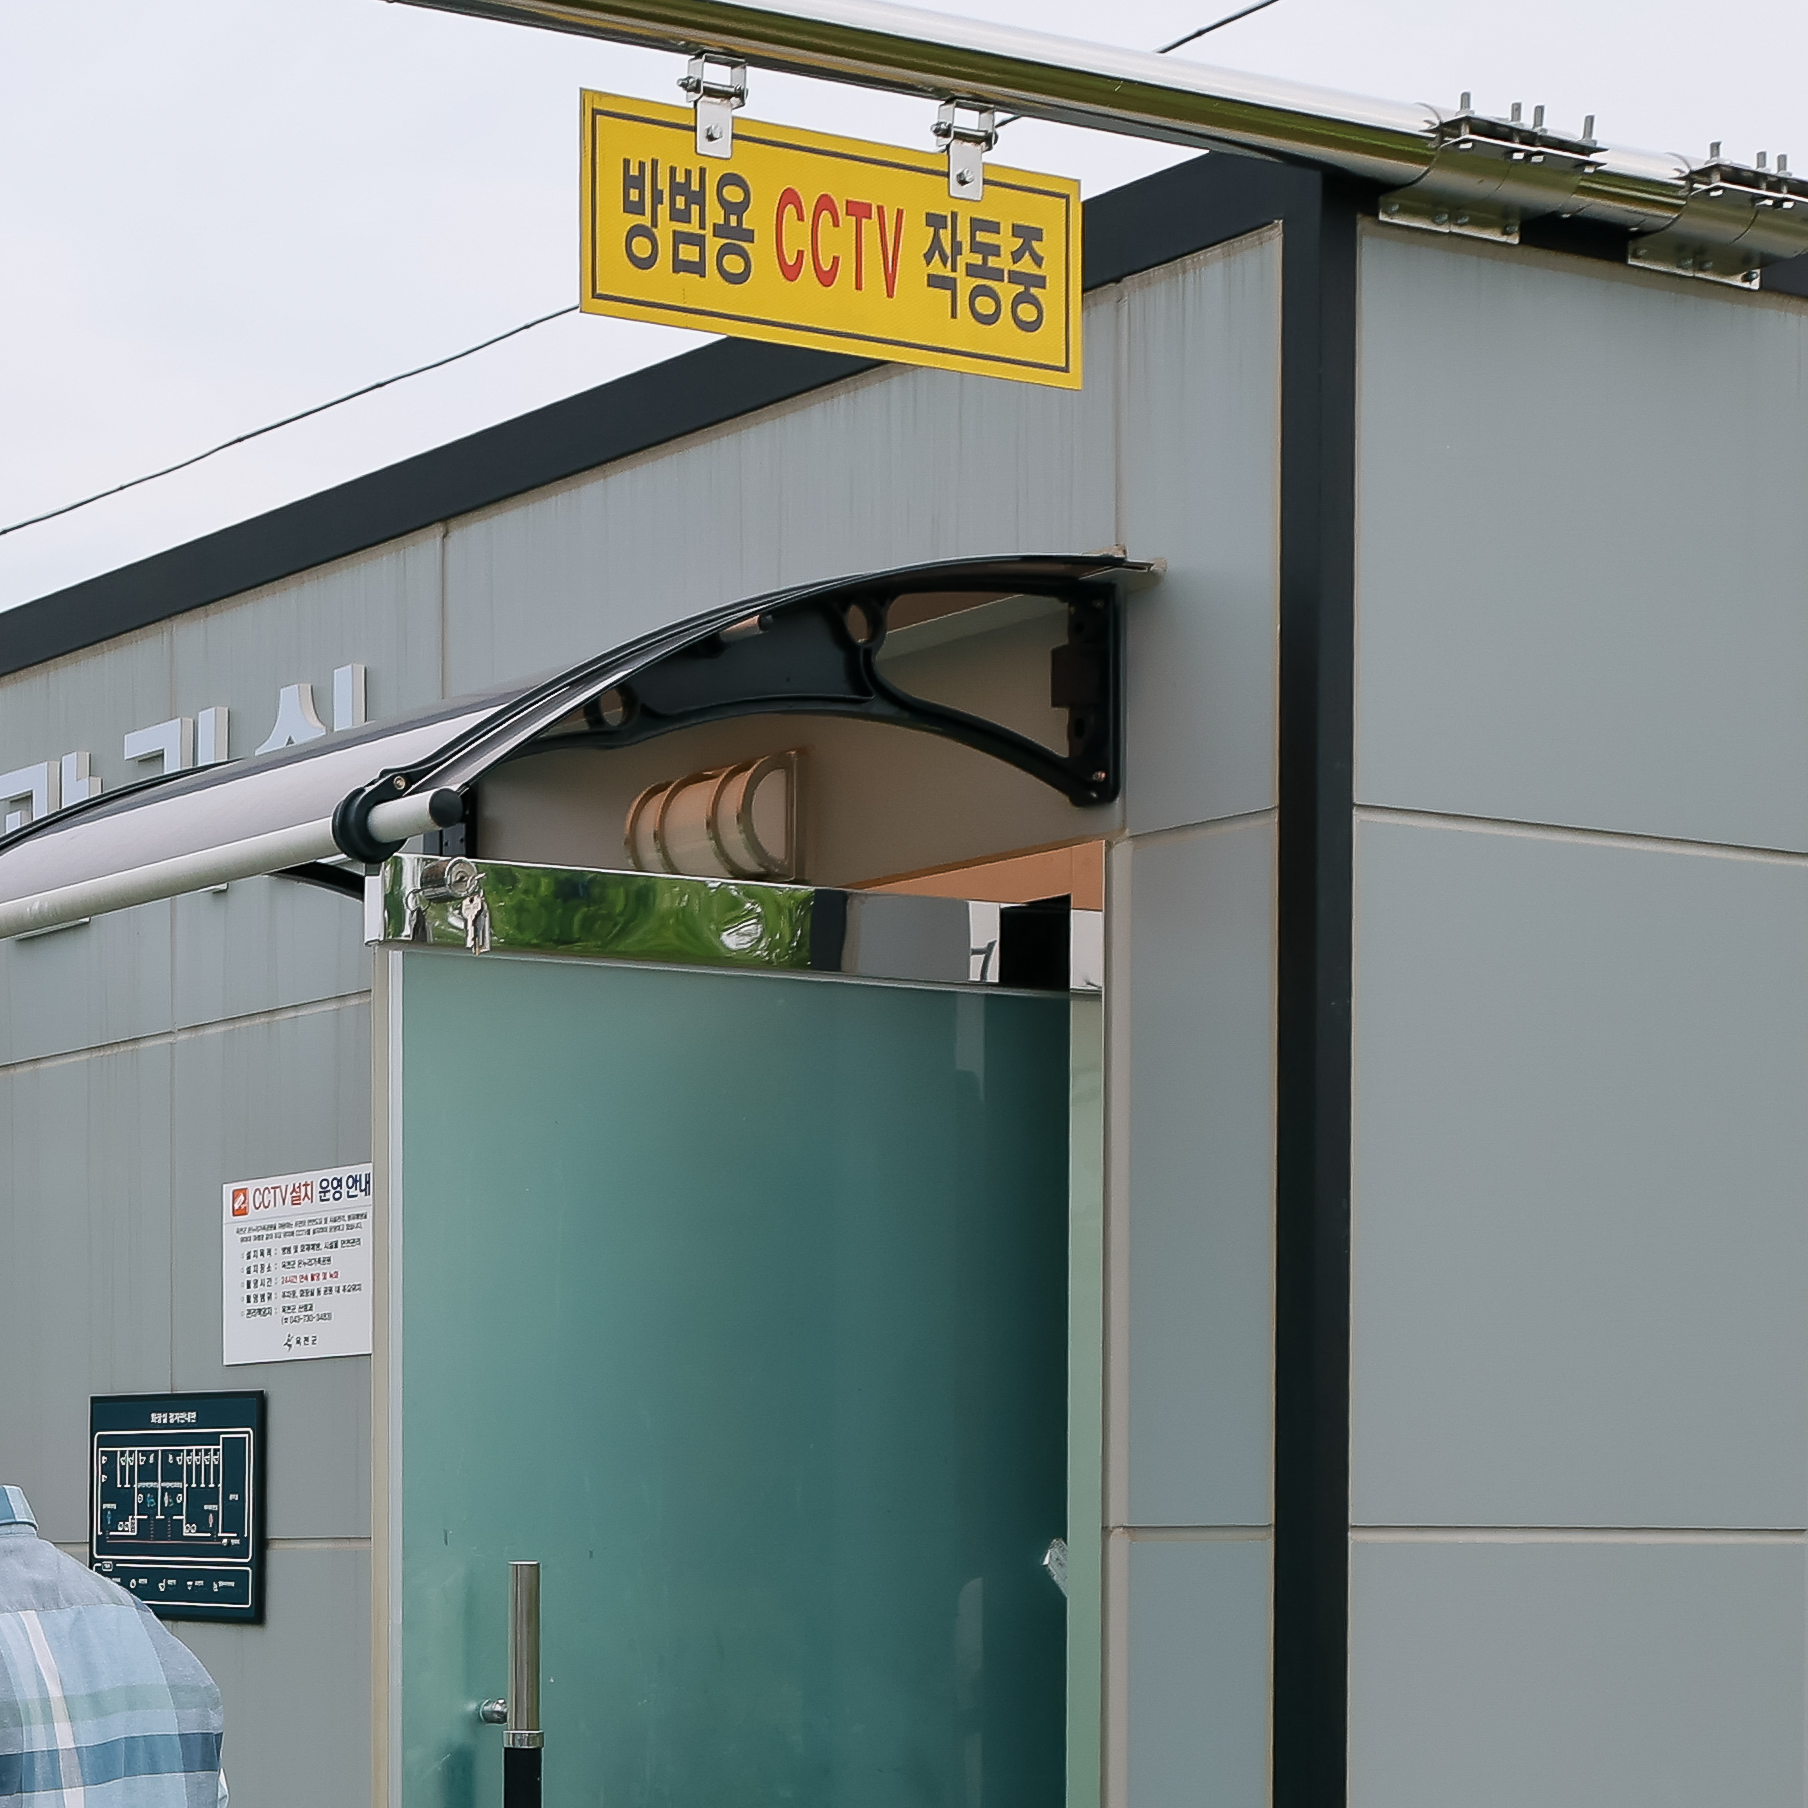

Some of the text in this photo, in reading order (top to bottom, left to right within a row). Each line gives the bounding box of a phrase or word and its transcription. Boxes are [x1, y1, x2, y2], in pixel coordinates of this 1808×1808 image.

[622, 157, 1047, 333] 방범용 CCTV 작동중
[253, 1172, 371, 1210] CCTV설치 운영 안내
[295, 1335, 318, 1346] 옥천군
